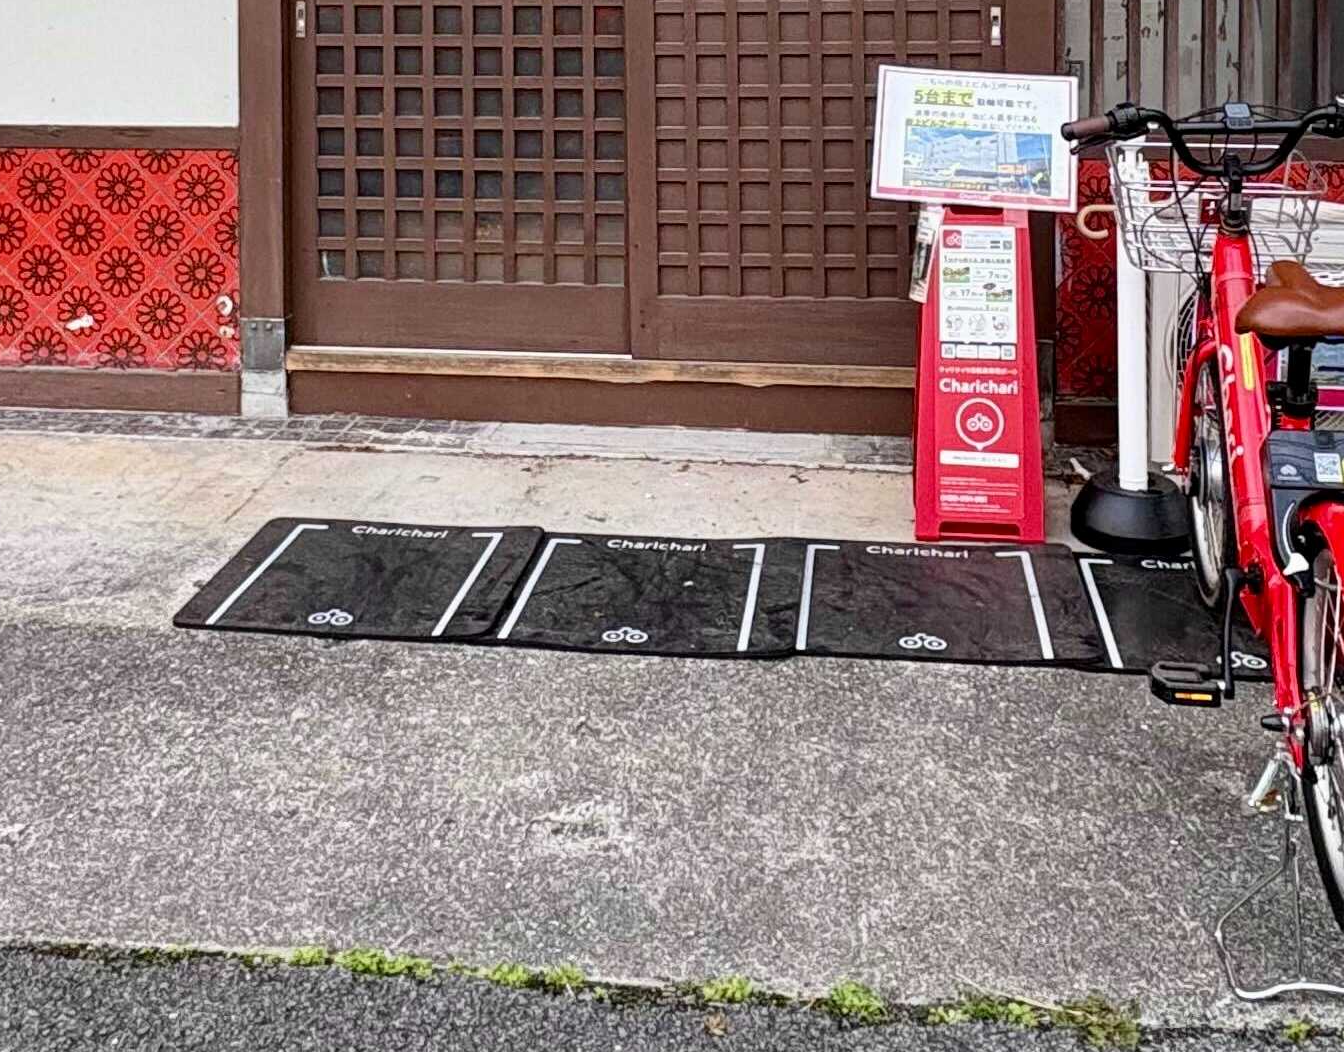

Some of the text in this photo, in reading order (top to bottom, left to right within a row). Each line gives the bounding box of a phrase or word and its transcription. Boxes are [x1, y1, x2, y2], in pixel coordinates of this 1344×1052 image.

[914, 89, 974, 105] 5台まで
[939, 378, 1019, 395] Charichari
[352, 524, 449, 540] Charichari
[607, 538, 708, 553] Charichari
[866, 545, 969, 560] Charichari
[1140, 559, 1196, 570] Chari
